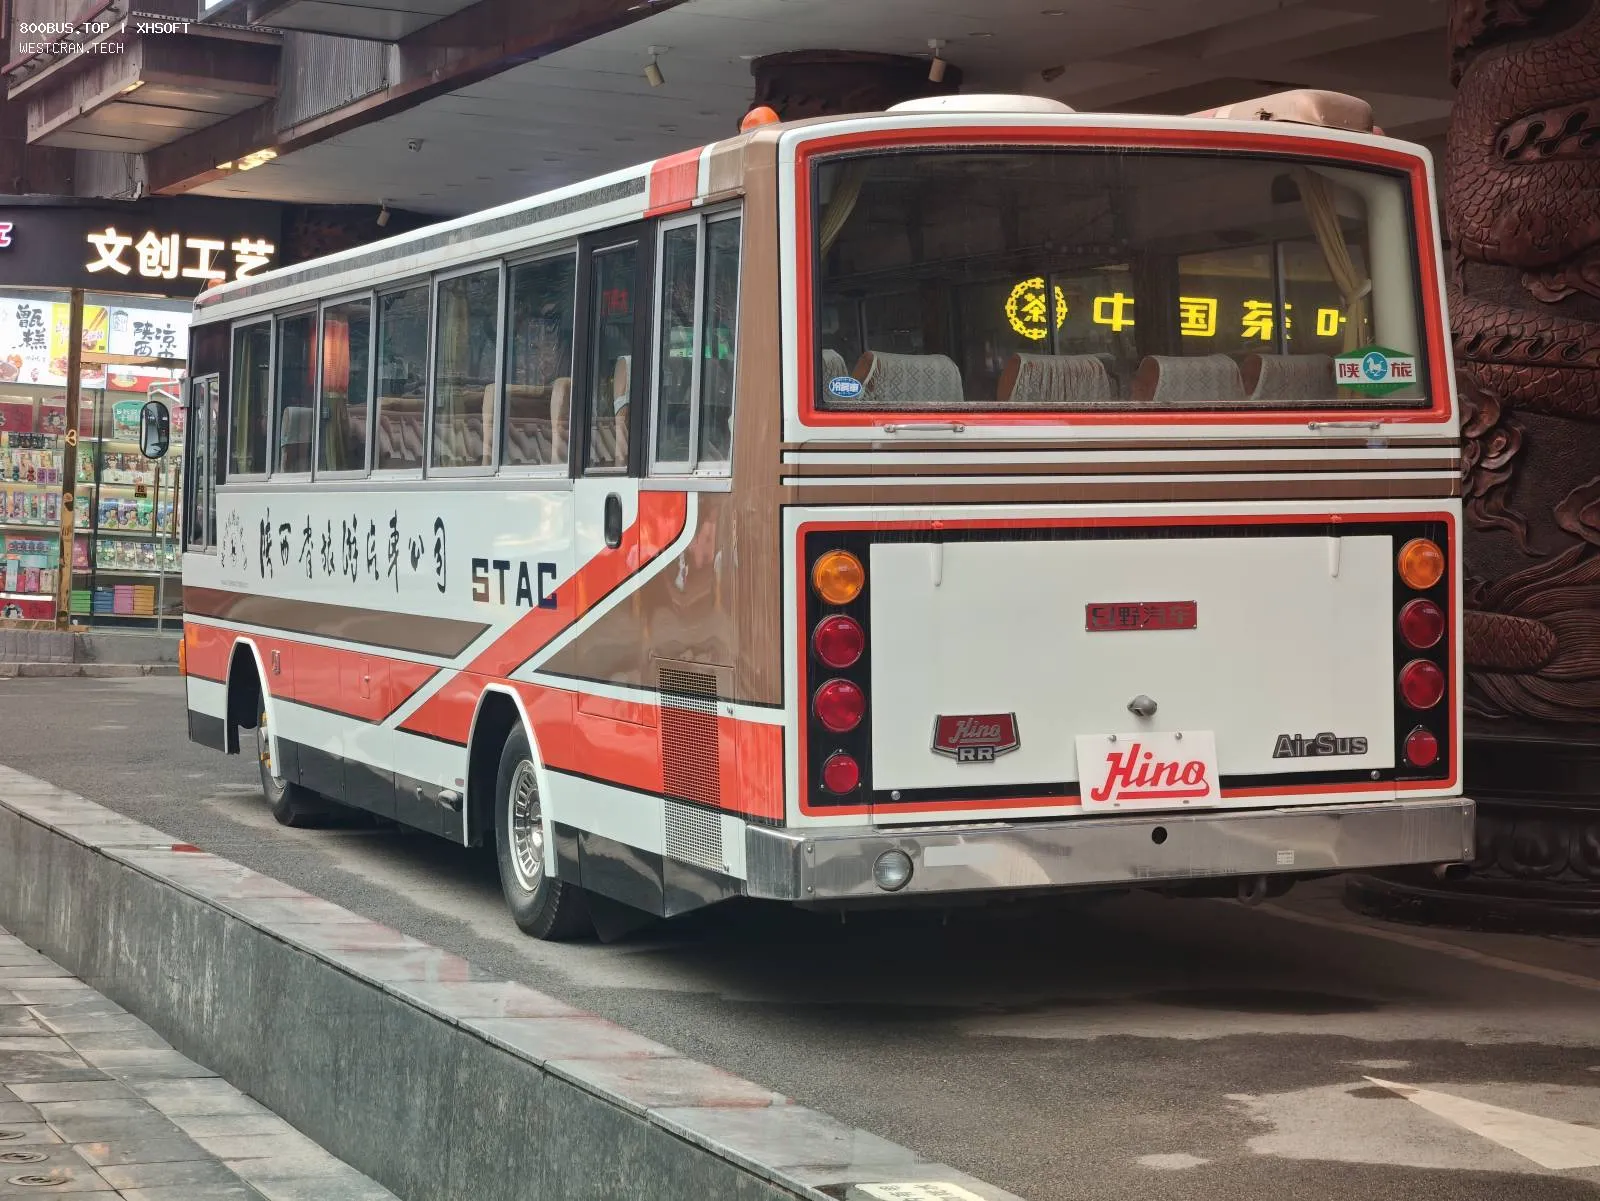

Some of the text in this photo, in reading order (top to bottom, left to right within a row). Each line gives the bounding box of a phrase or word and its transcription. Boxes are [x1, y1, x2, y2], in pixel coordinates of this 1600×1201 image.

[85, 226, 275, 281] 文创工艺
[471, 557, 558, 610] STAC
[1092, 604, 1193, 627] 日野汽车
[948, 717, 1002, 744] Hino
[959, 747, 995, 761] RR
[1090, 743, 1210, 802] Hino
